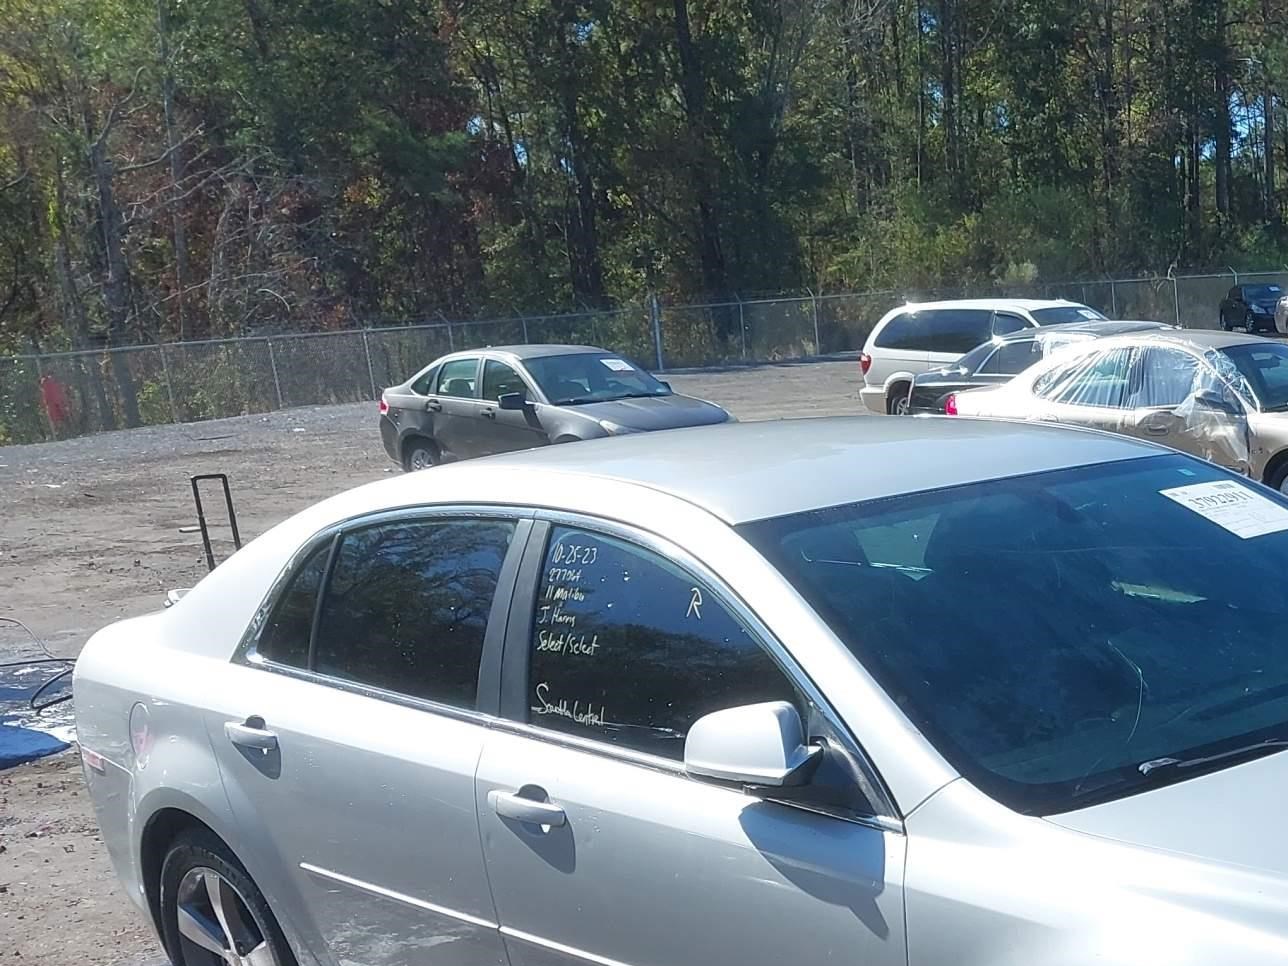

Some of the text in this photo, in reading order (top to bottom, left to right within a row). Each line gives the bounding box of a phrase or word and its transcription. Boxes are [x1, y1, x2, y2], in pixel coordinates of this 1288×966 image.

[1188, 491, 1254, 509] 37922911
[551, 542, 598, 565] 10-25-23
[686, 587, 703, 619] R
